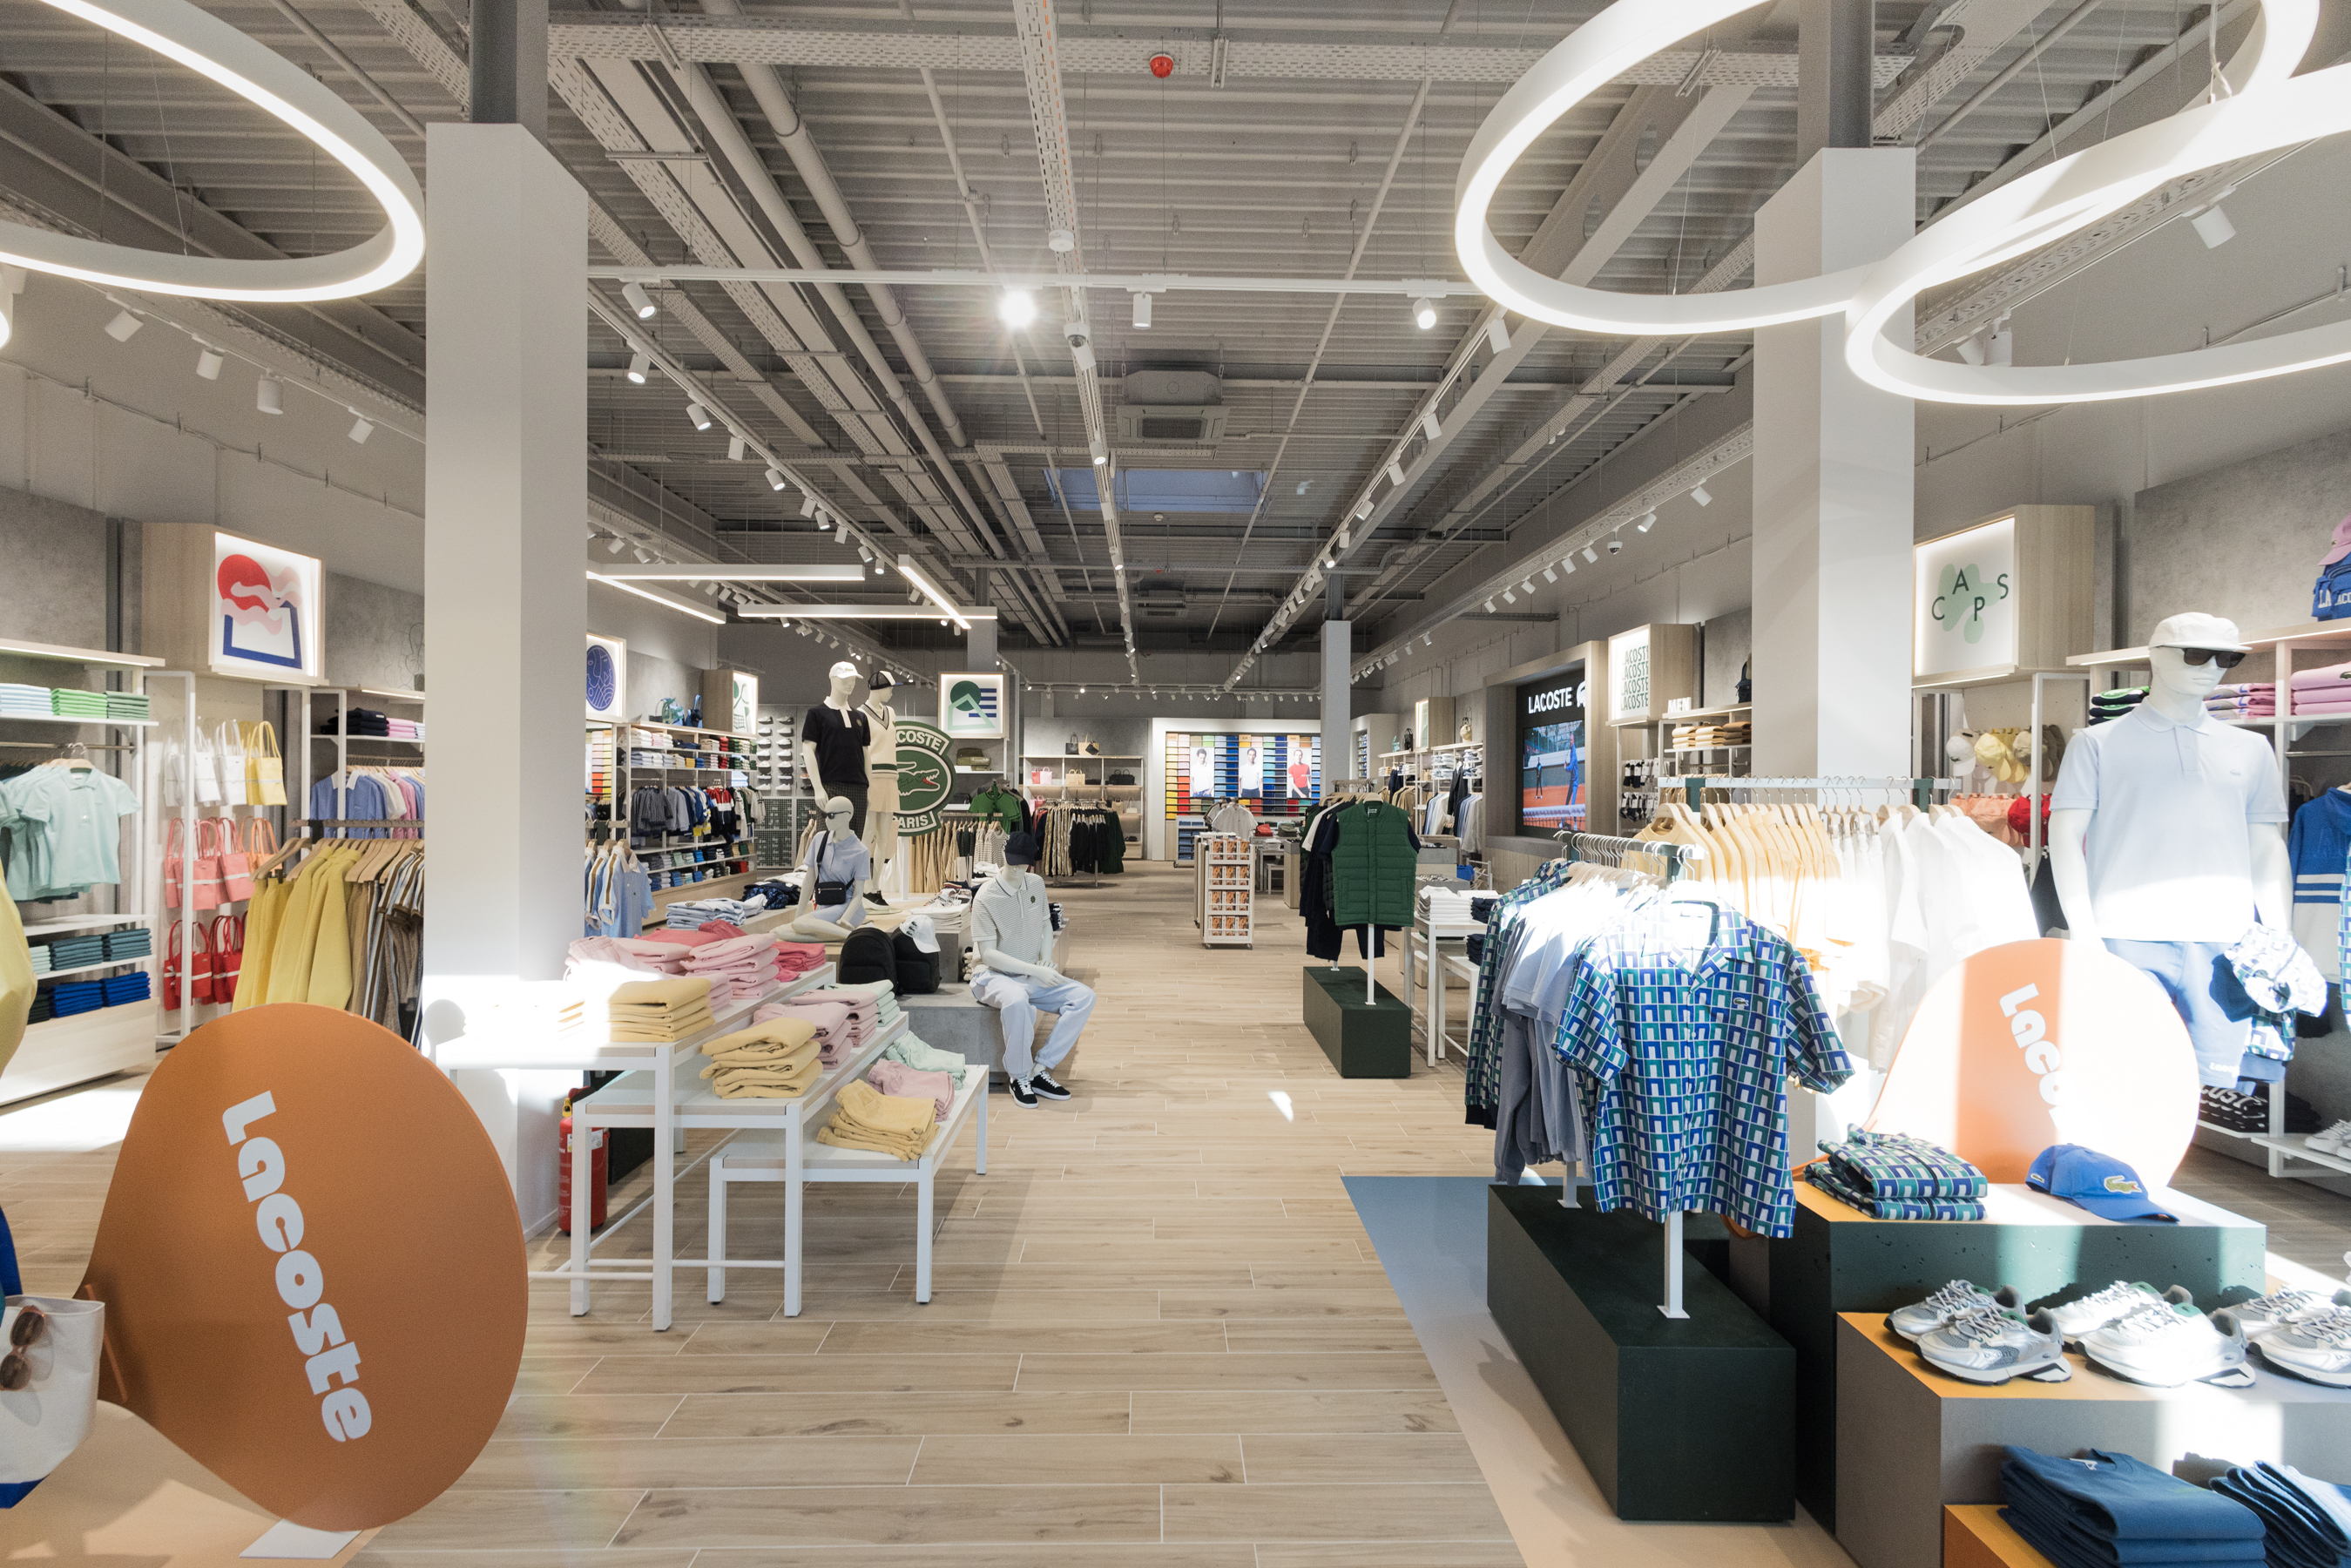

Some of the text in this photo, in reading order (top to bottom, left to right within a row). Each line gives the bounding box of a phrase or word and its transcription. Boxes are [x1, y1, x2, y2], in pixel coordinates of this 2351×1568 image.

[1931, 567, 2010, 622] CAPS
[1528, 686, 1573, 714] LACOSTE
[1667, 697, 1692, 714] MEN
[222, 1090, 372, 1443] Lacoste
